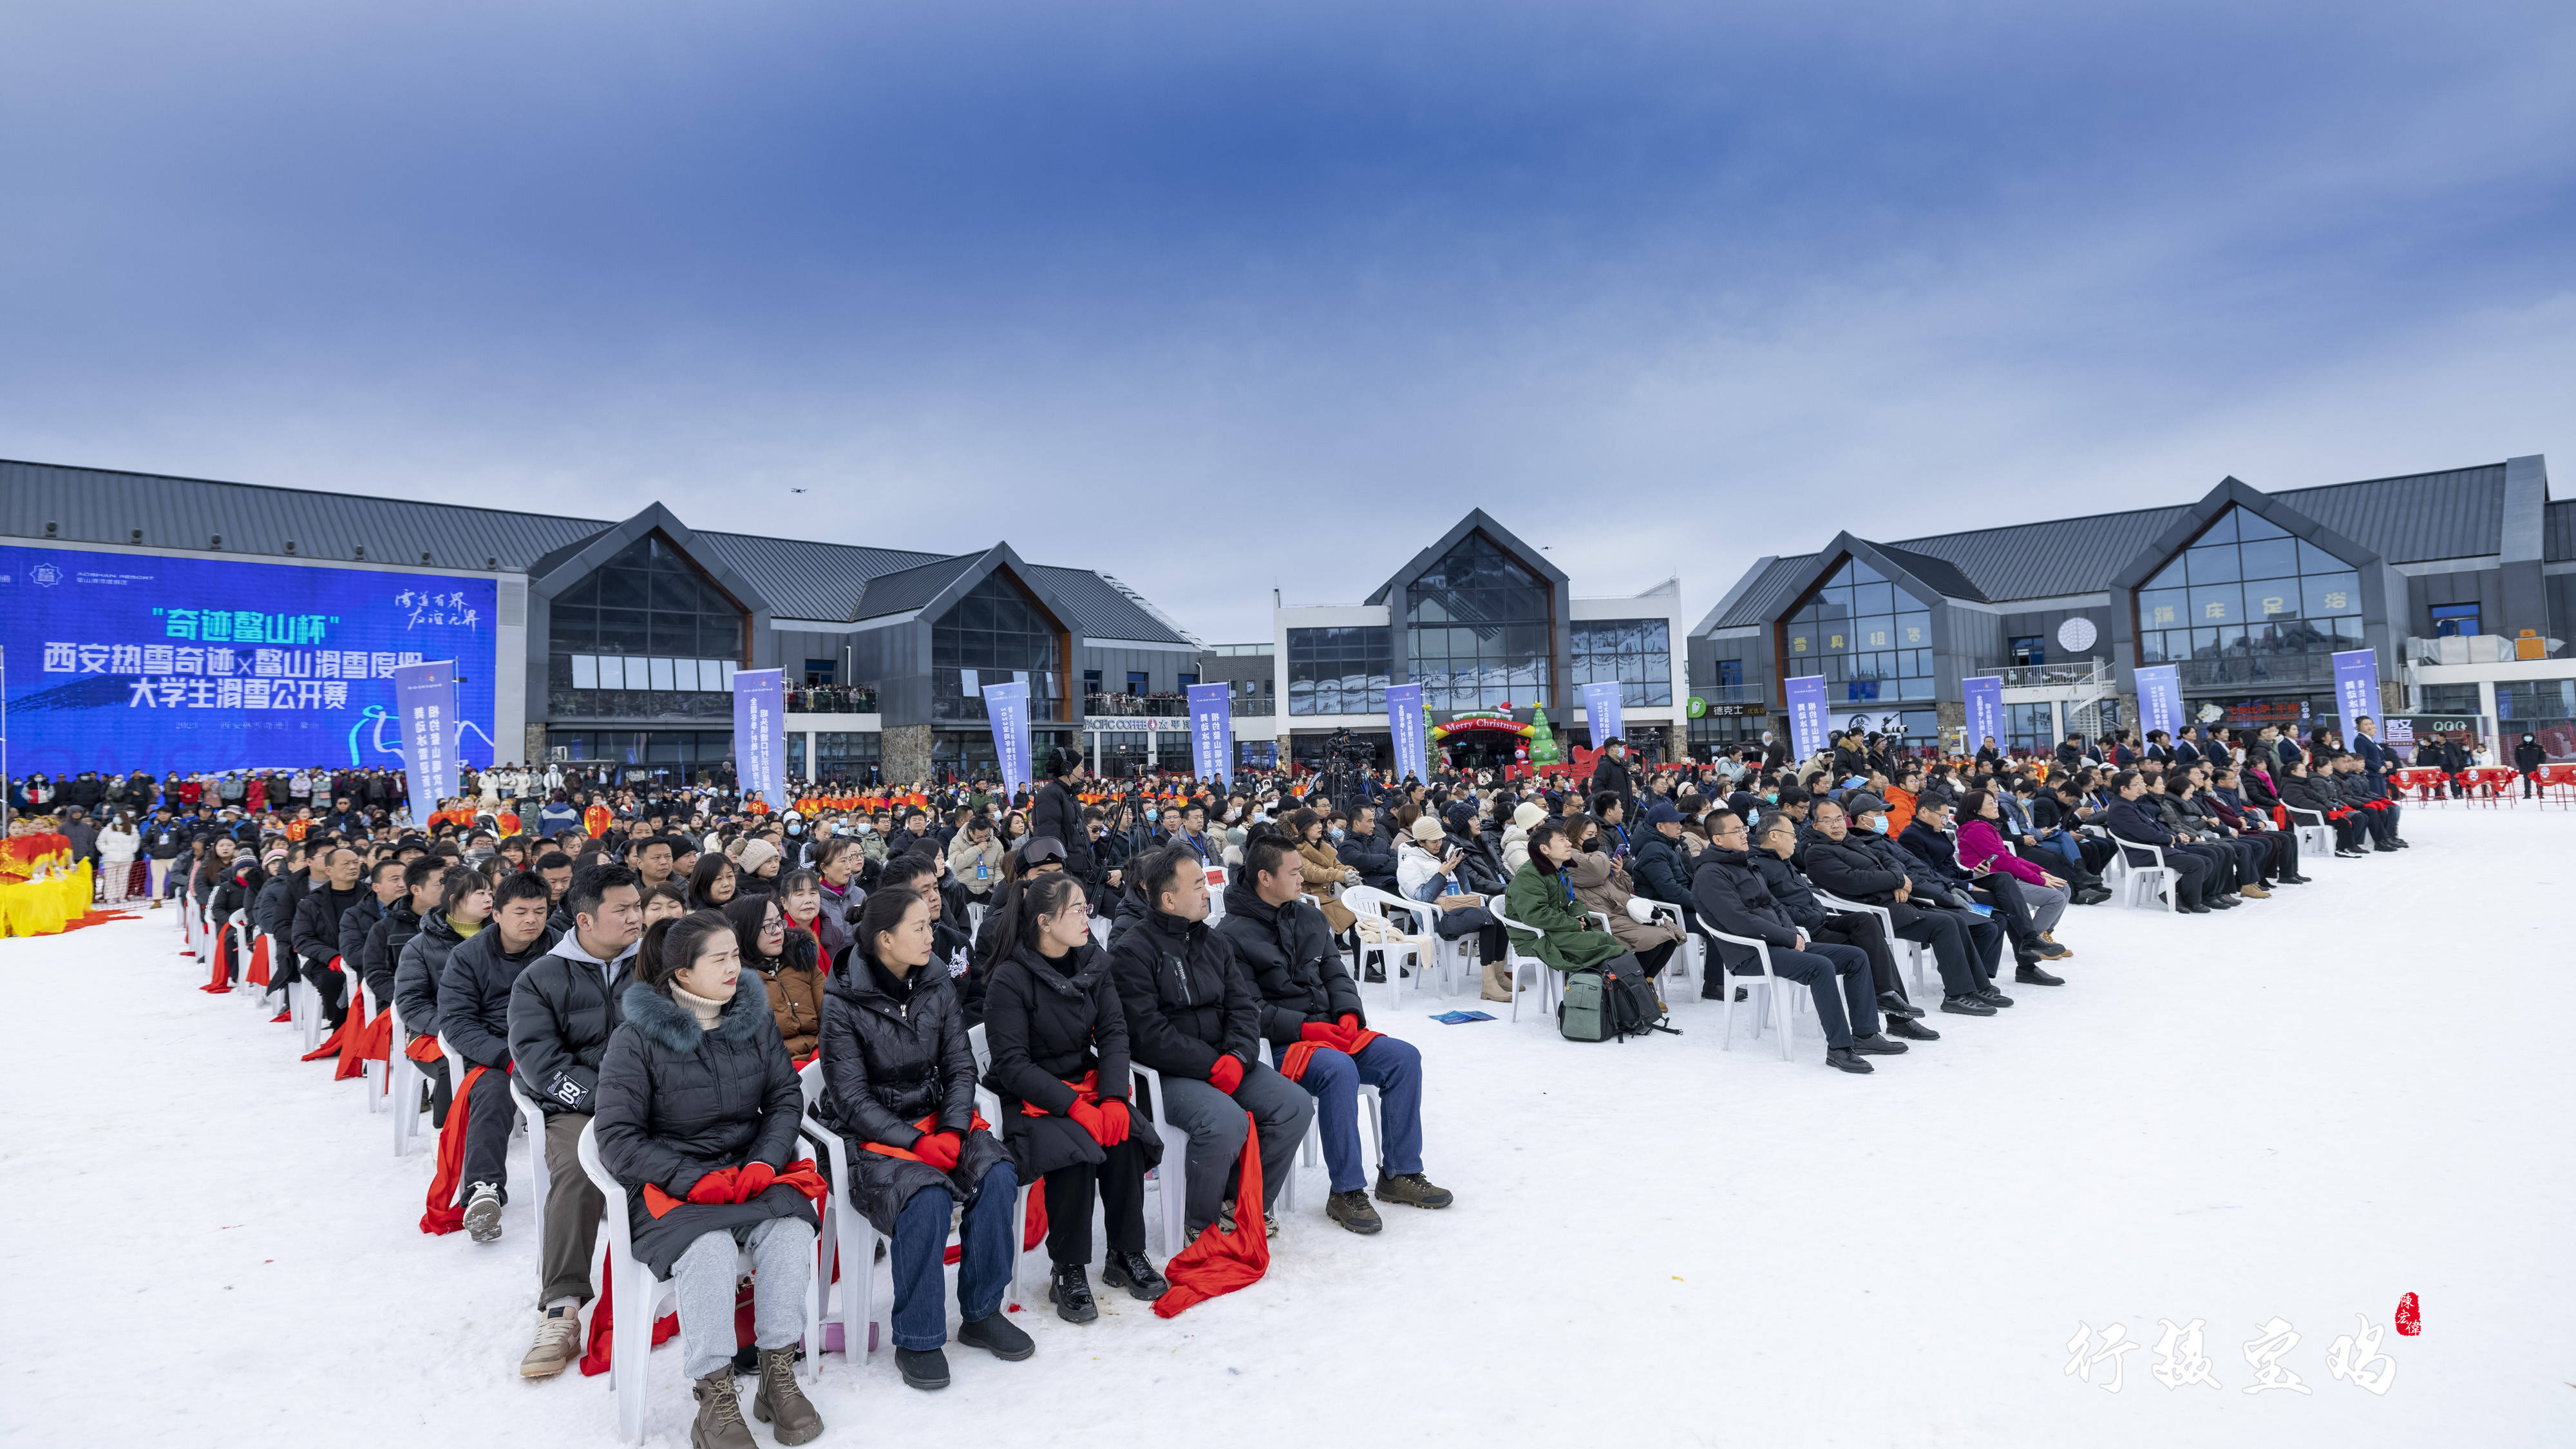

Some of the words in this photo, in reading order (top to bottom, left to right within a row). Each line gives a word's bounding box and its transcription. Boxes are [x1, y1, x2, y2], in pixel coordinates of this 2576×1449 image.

[1794, 627, 1921, 652] 雪具租赁
[129, 677, 349, 710] 大学生滑雪公开赛
[1714, 706, 1743, 715] 德克士
[1084, 719, 1115, 730] PACIFIC
[1116, 719, 1147, 730] COFFEE
[1445, 722, 1473, 732] Merry
[1476, 719, 1521, 732] Christmas
[1177, 961, 1186, 980] OUTDOOR
[554, 1071, 562, 1081] STAGE
[558, 1082, 580, 1104] 09
